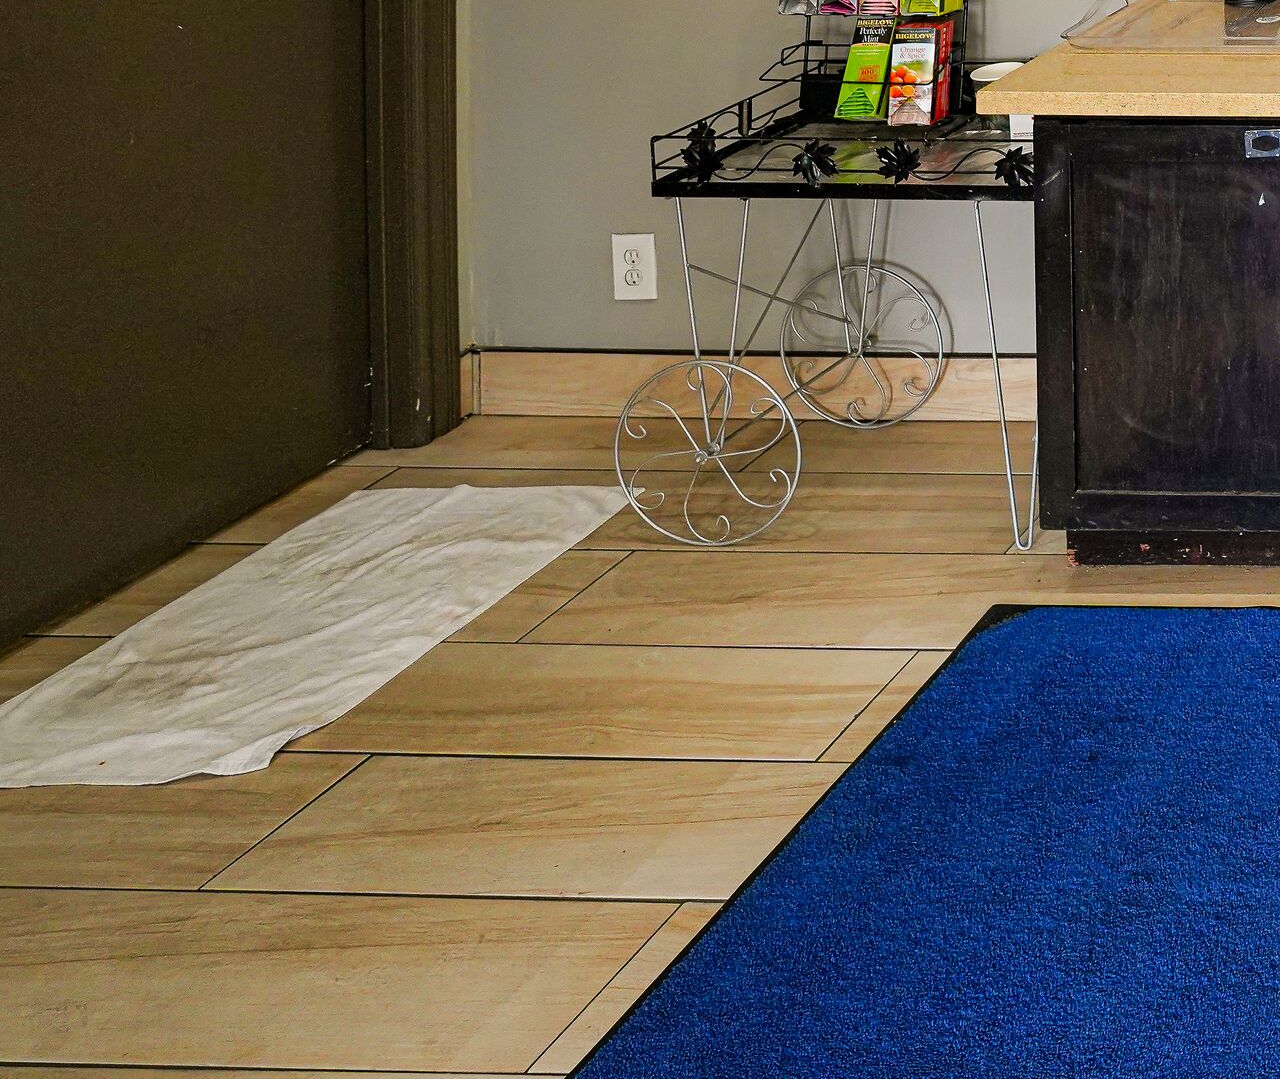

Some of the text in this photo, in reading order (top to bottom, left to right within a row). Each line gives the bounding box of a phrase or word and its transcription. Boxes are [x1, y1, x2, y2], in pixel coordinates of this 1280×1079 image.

[860, 26, 888, 36] Perfectly
[862, 35, 880, 43] Mint
[907, 52, 926, 60] Spice
